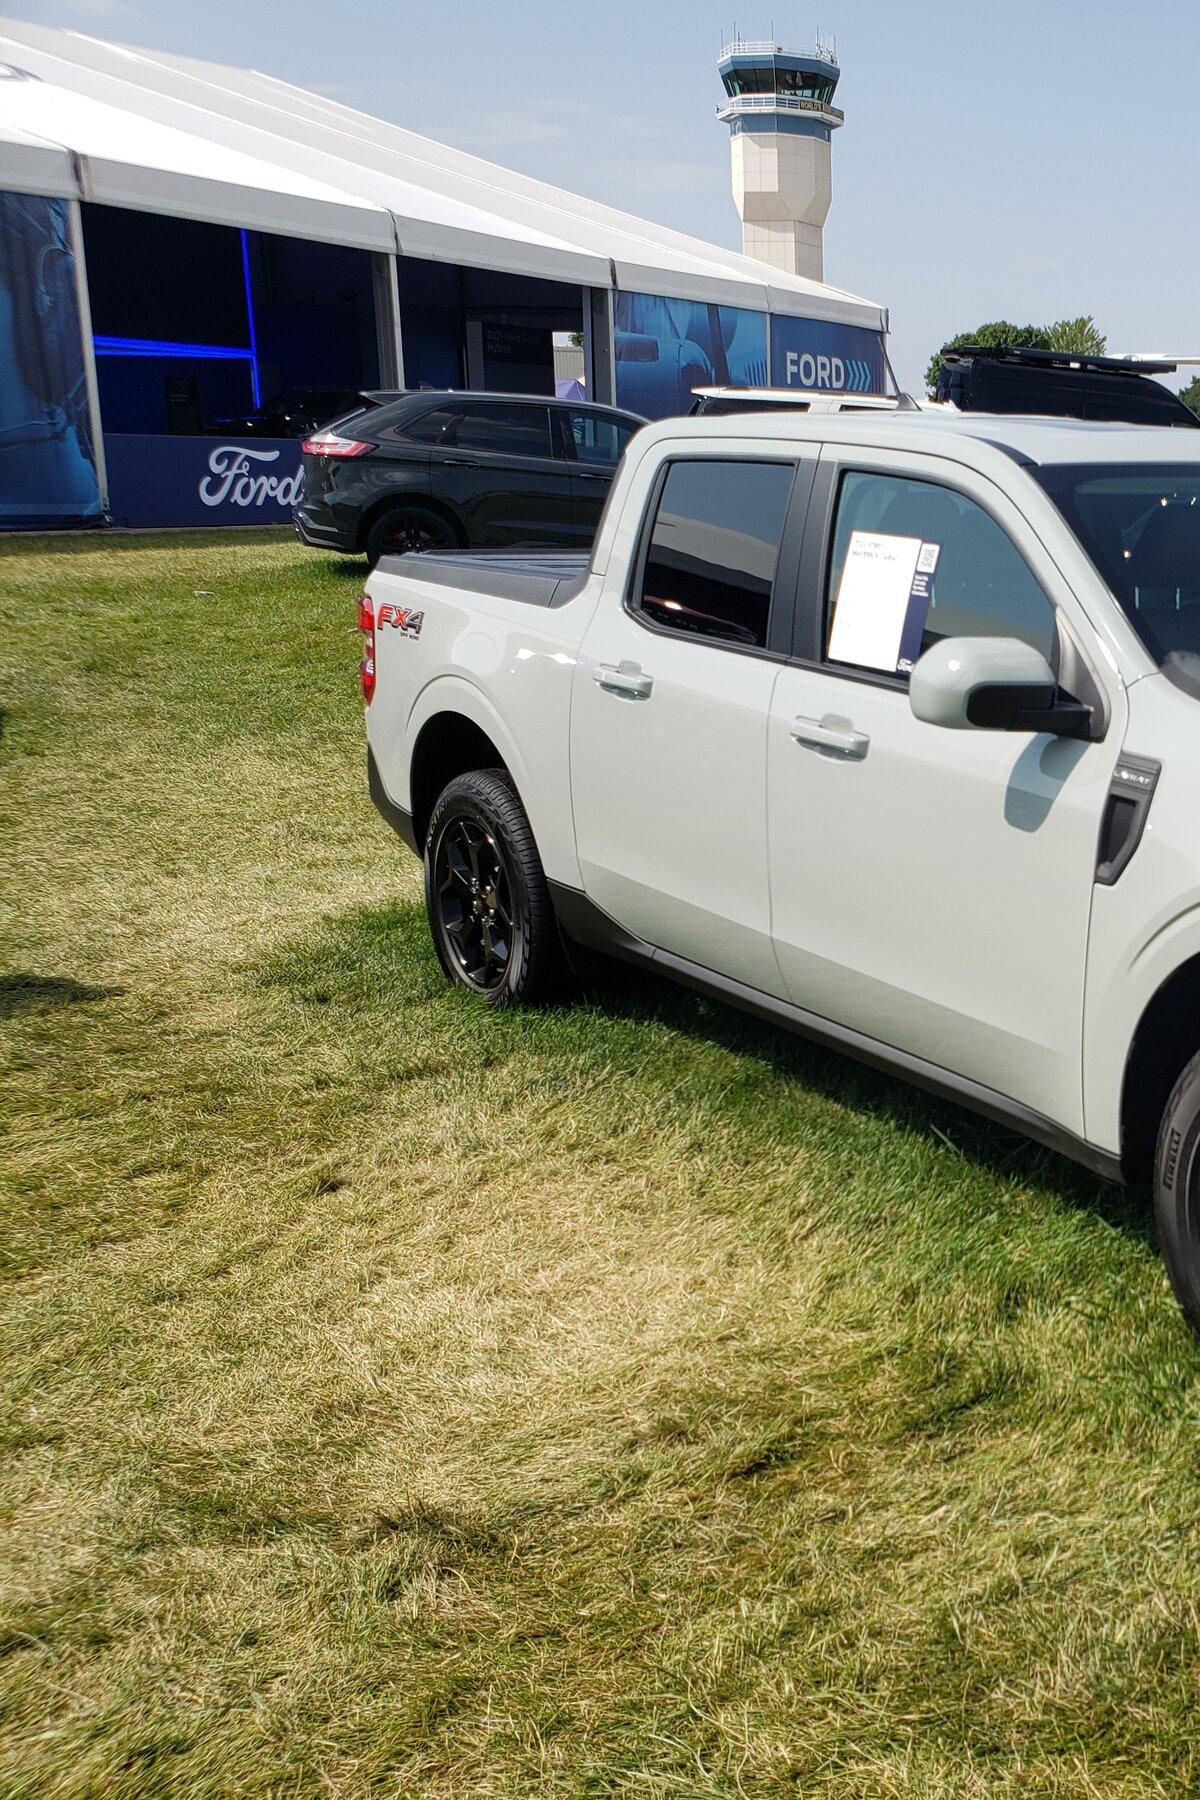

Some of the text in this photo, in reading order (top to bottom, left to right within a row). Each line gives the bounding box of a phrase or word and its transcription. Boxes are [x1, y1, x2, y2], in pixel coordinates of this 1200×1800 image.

[786, 351, 845, 389] FORD
[199, 445, 305, 507] Ford
[377, 602, 425, 634] FX4
[1163, 1127, 1182, 1191] PIRELLI
